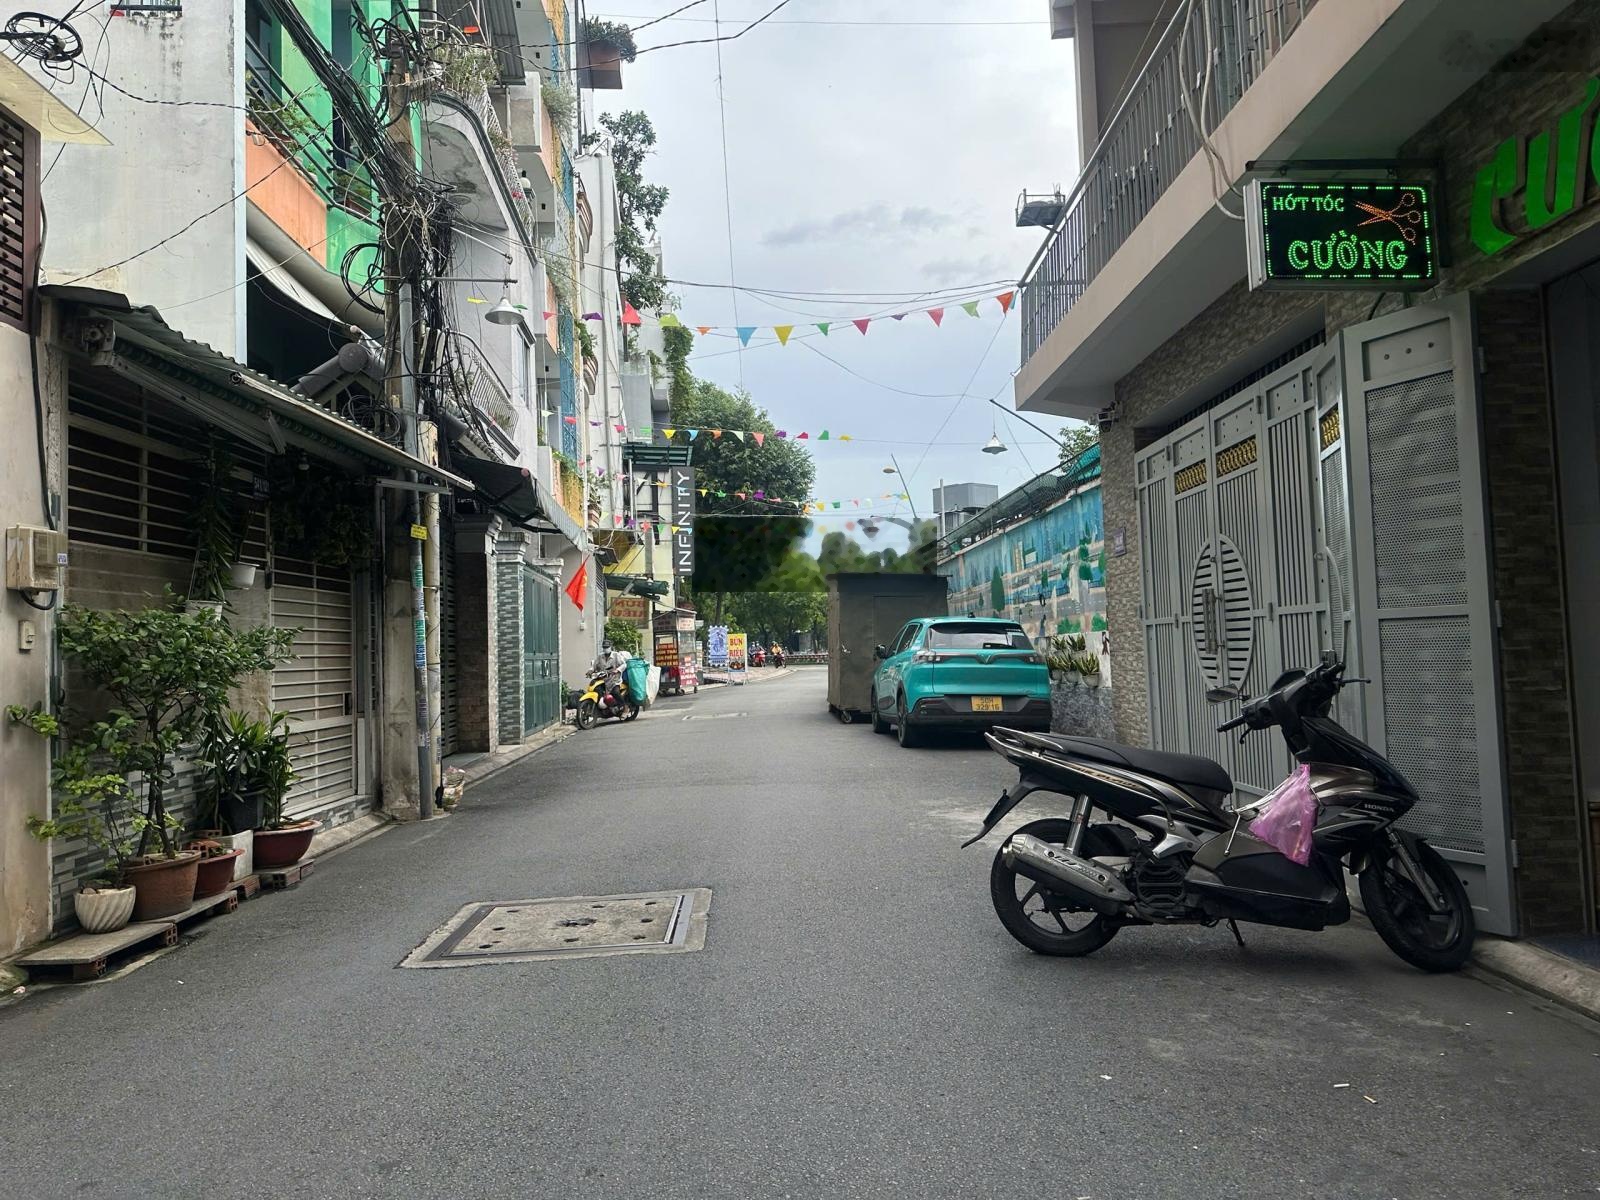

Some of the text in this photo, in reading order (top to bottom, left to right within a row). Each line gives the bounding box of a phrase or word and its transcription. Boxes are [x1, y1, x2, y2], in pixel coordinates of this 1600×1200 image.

[1272, 193, 1345, 212] HỚT TÓC
[1288, 230, 1409, 270] CƯỜNG
[677, 471, 692, 572] INFINITY
[1364, 803, 1394, 812] HONDA
